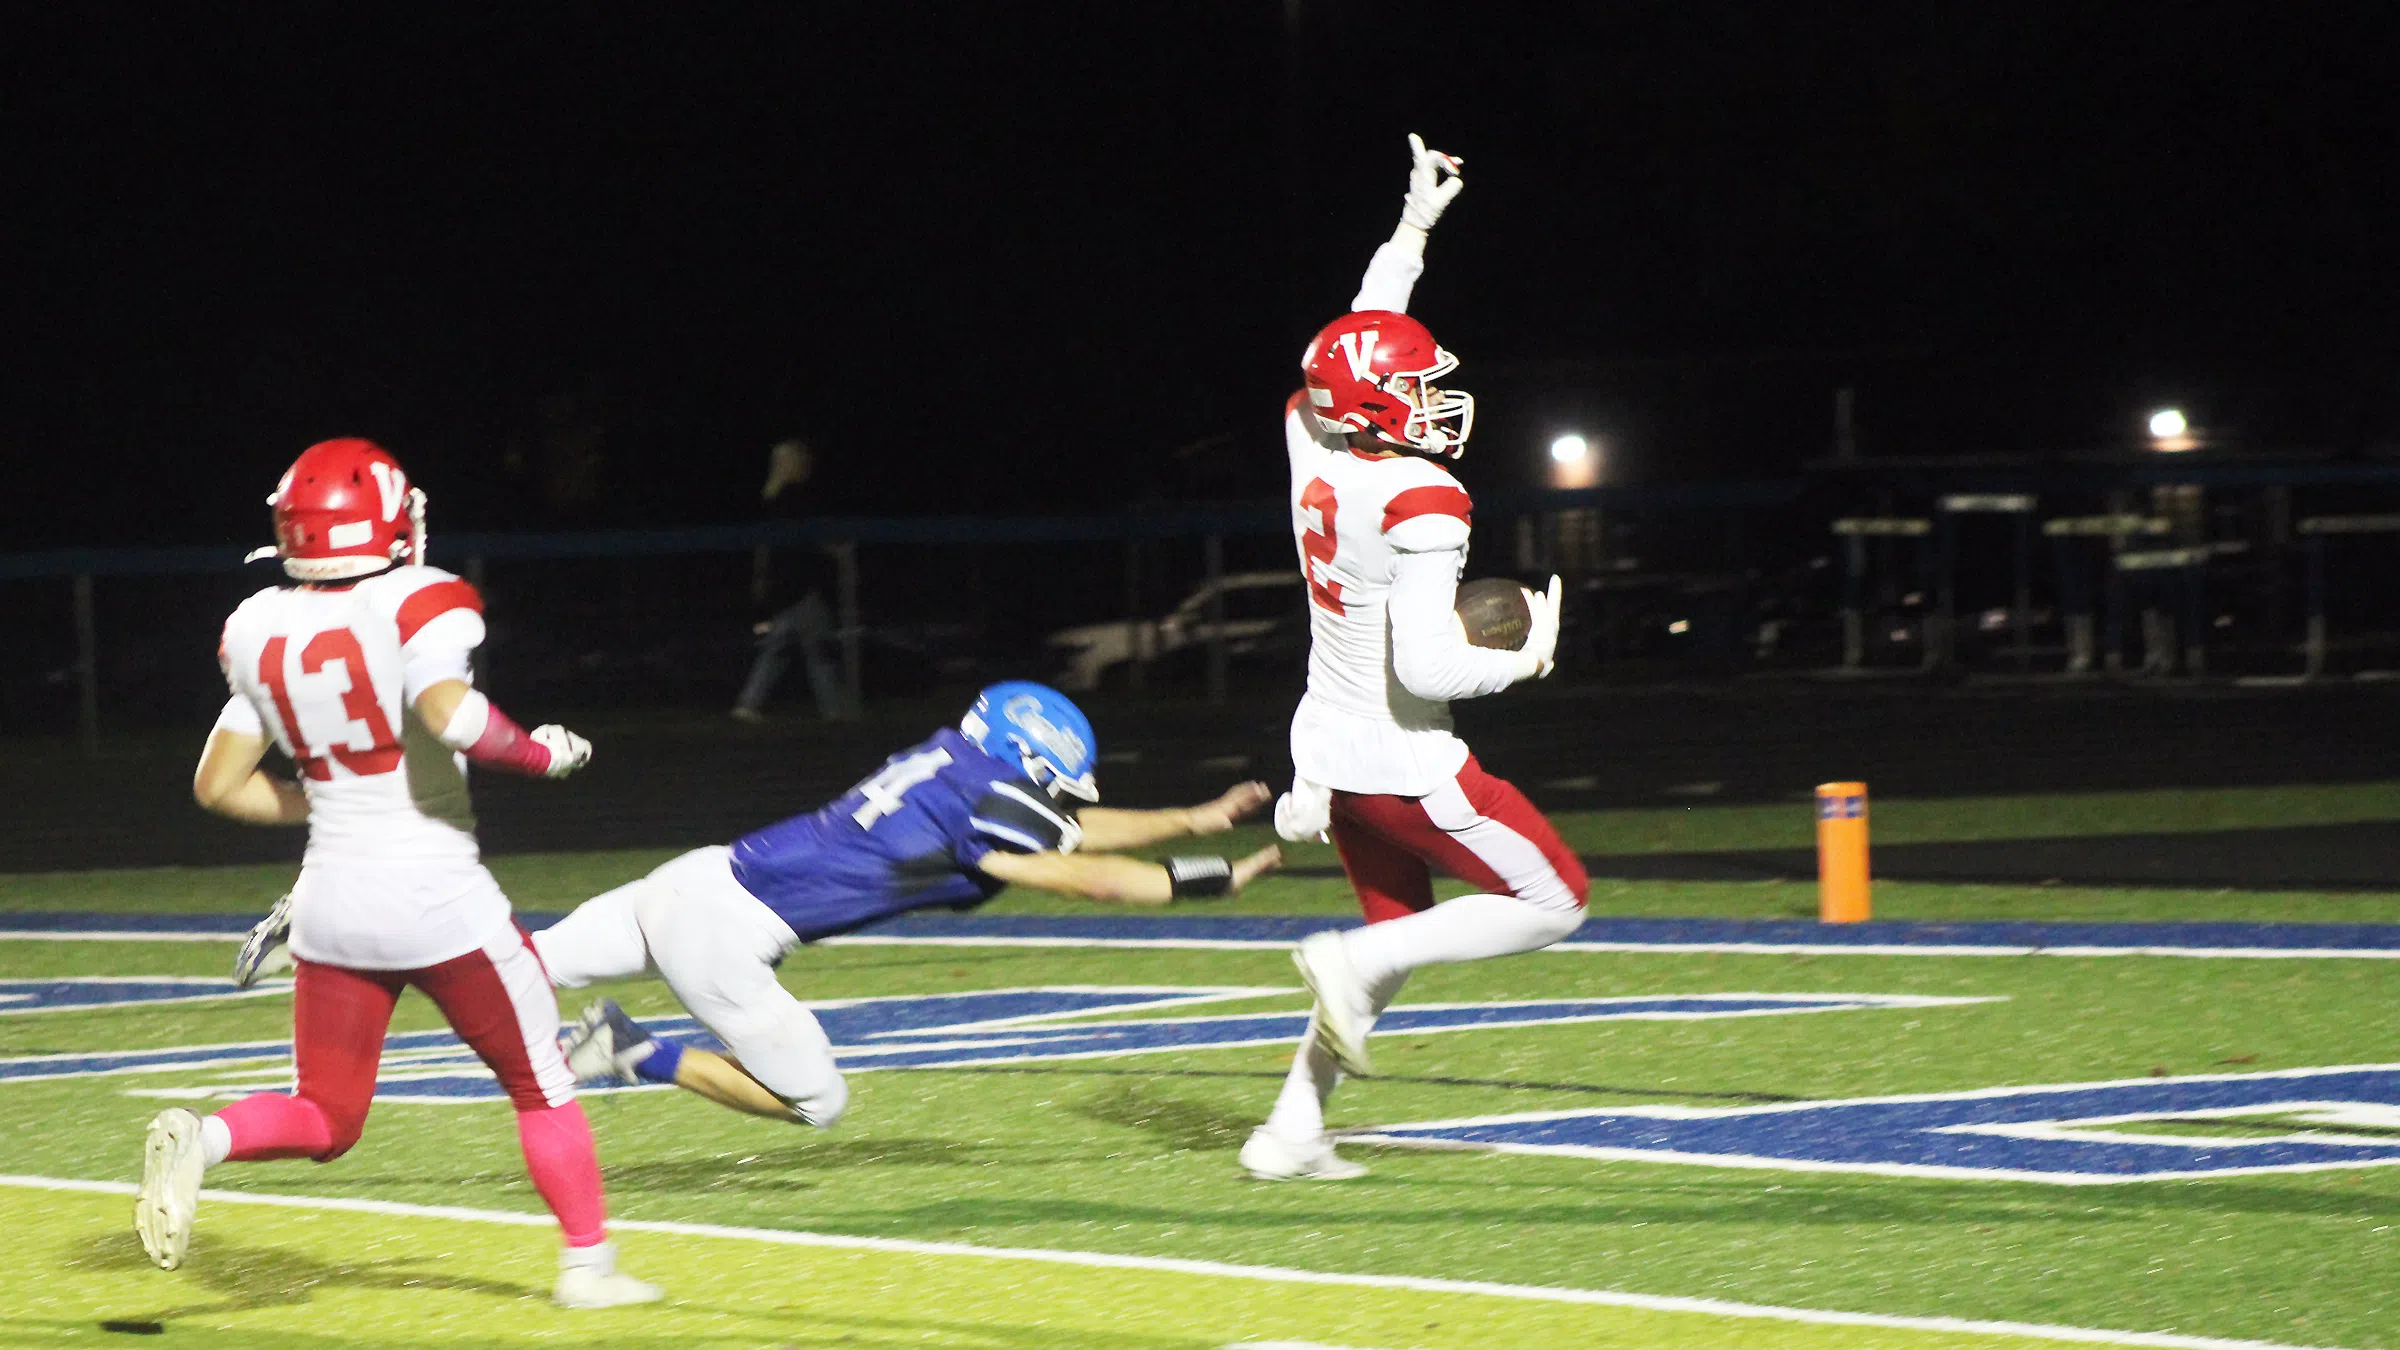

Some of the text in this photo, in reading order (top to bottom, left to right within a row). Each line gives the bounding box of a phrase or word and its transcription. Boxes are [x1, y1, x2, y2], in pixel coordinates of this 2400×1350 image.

[1340, 331, 1379, 382] V
[369, 461, 406, 523] V
[1300, 477, 1346, 617] 2
[258, 627, 406, 781] 13
